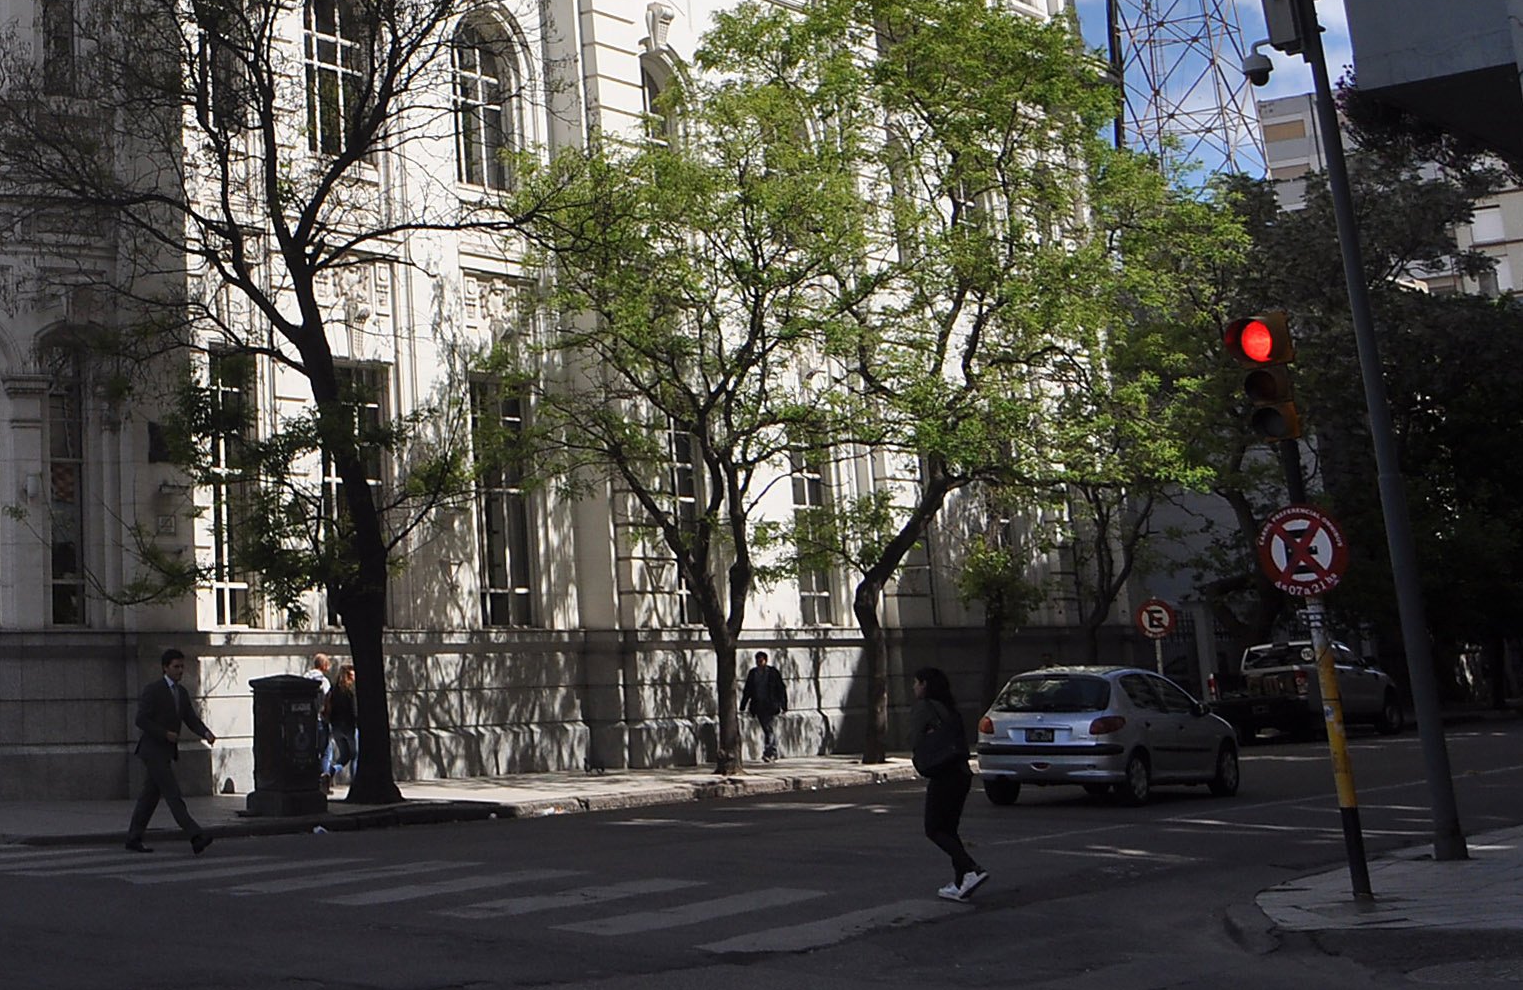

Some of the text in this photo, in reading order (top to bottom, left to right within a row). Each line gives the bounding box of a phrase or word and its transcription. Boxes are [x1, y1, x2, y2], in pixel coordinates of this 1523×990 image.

[1272, 508, 1320, 522] PREFERENCIAL
[1274, 580, 1288, 591] de
[1288, 585, 1303, 595] 07
[1311, 580, 1326, 593] 21
